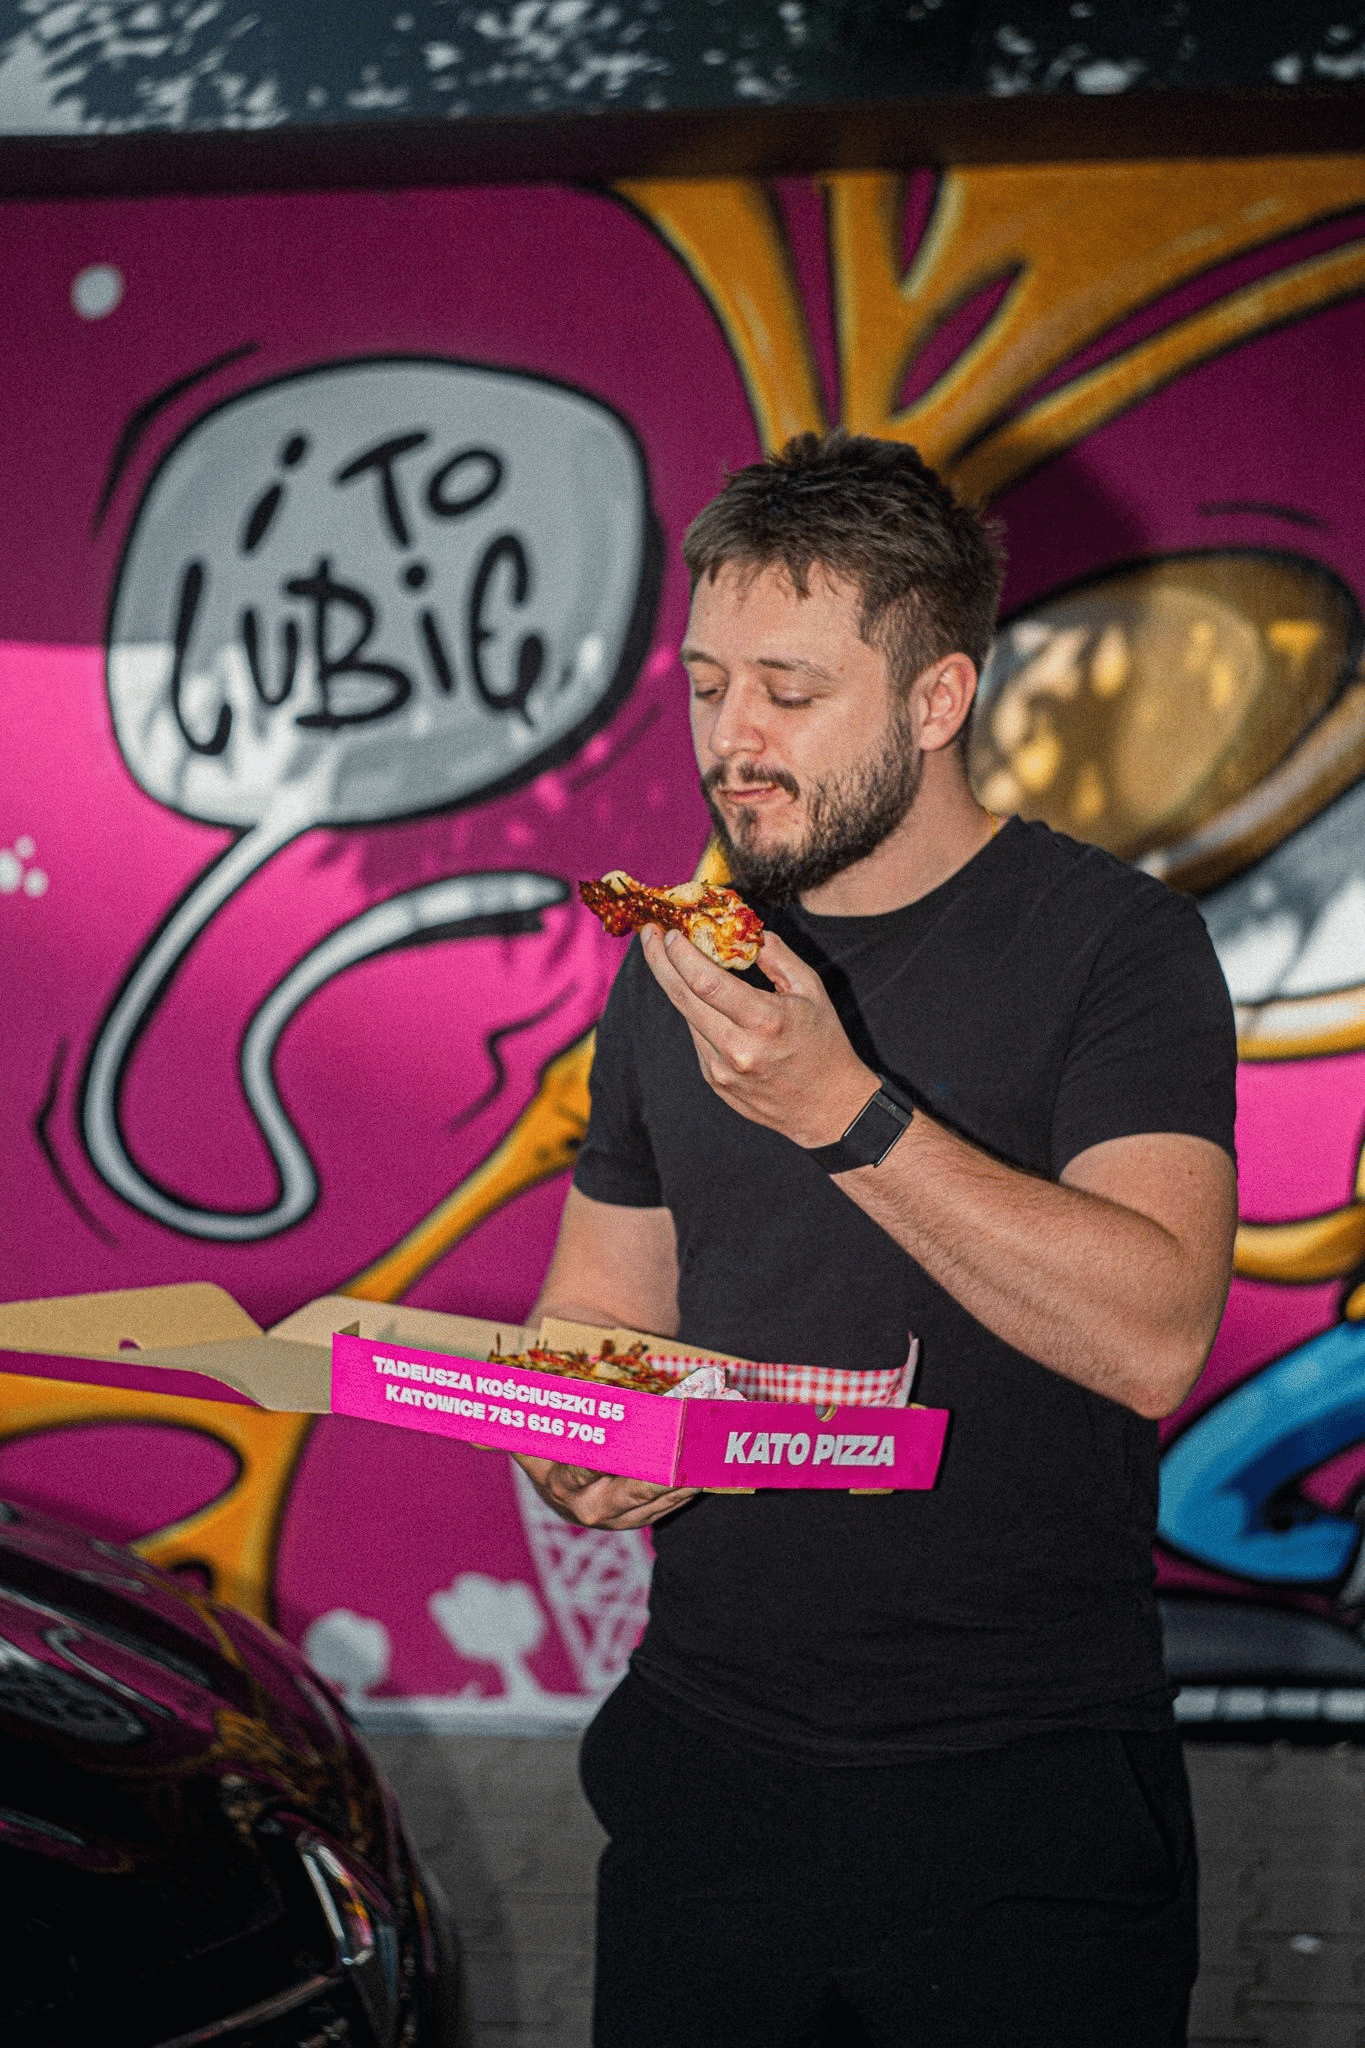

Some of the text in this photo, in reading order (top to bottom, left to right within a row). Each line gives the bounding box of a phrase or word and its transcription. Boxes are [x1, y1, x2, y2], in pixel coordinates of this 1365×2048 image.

[330, 428, 505, 550] TO
[372, 1355, 625, 1421] TADEUSZA KOŚCIUSZKI 55
[385, 1383, 606, 1445] KATOWICE 783 616 705
[724, 1431, 896, 1467] KATO PIZZA
